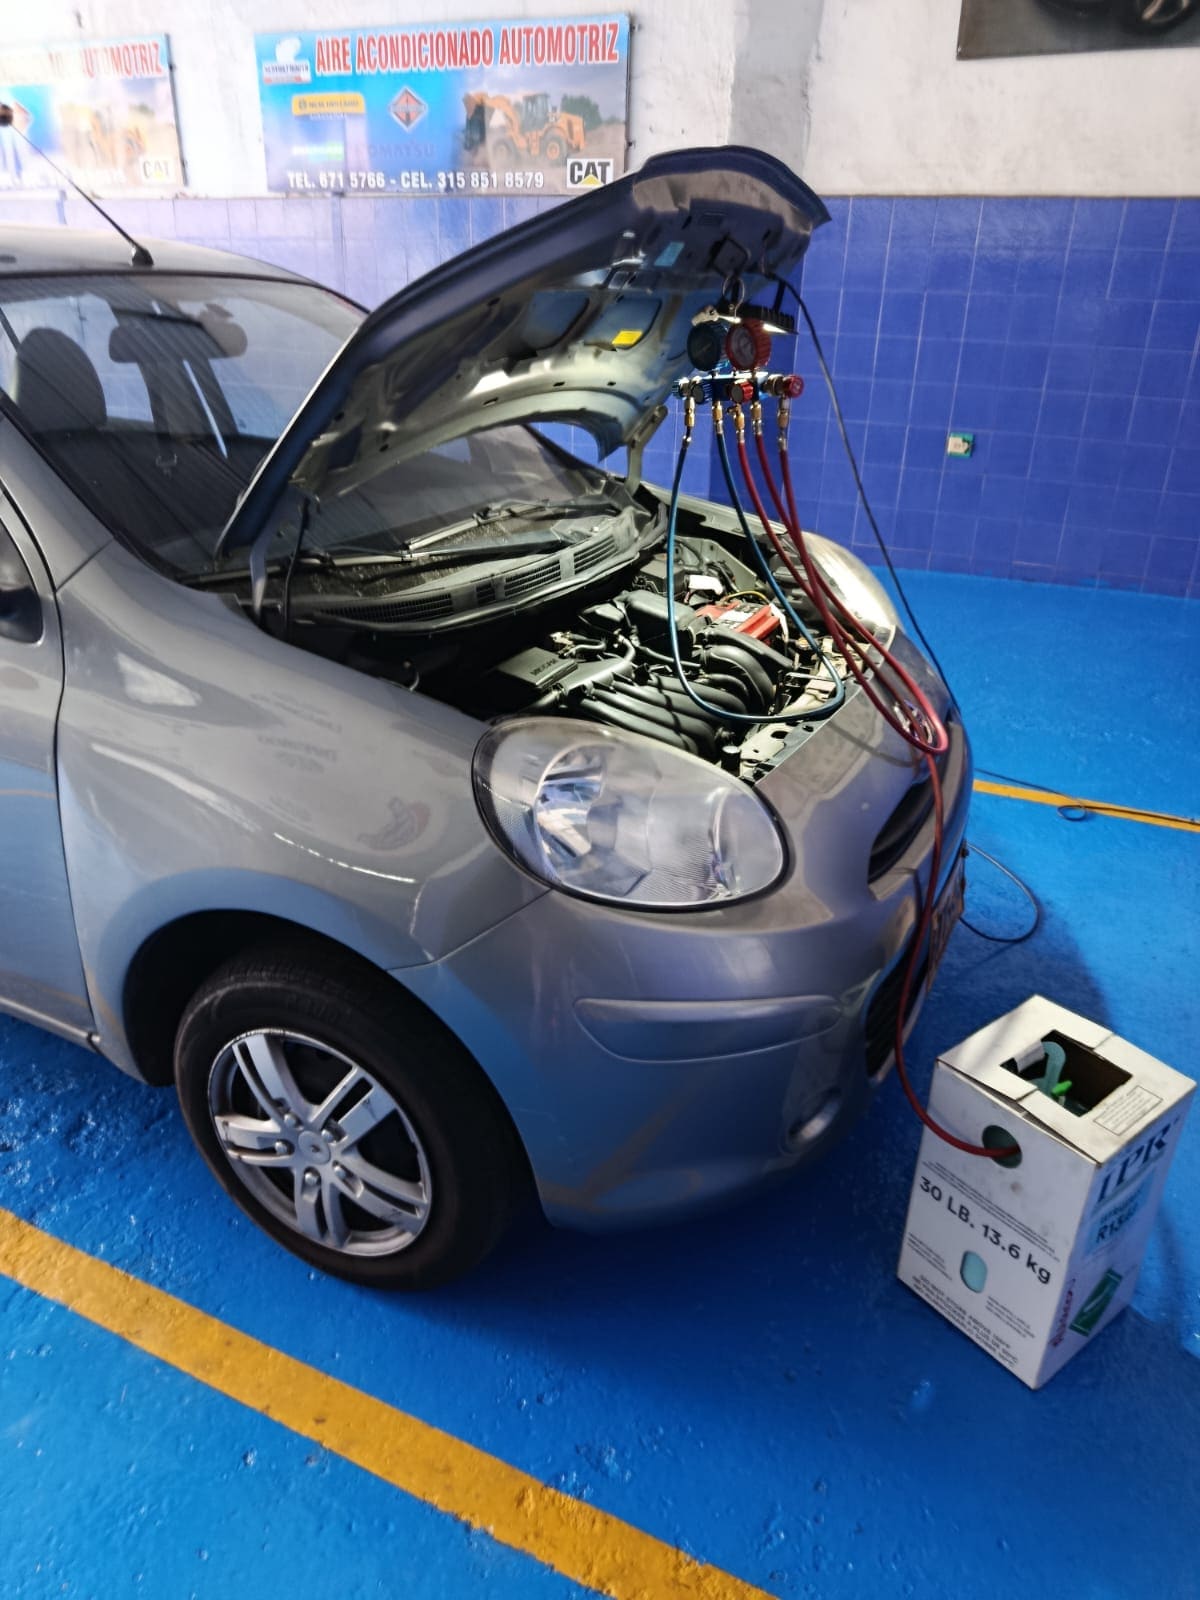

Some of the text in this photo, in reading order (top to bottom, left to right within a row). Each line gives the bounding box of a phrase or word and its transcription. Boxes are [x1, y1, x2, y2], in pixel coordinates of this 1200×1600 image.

[316, 22, 619, 72] AIRE ACONDICIONADO AUTOMOTRIZ
[143, 160, 170, 179] CAT
[287, 171, 316, 189] TEL.
[319, 171, 345, 189] 671
[350, 171, 385, 189] 5766
[401, 170, 433, 189] CEL.
[437, 171, 466, 189] 315
[470, 171, 498, 189] 851
[504, 171, 545, 189] 8579
[569, 160, 611, 185] CAT
[919, 1175, 943, 1202] 30
[946, 1196, 975, 1229] LB.
[982, 1224, 1021, 1260] 13.6
[1025, 1253, 1052, 1286] kg
